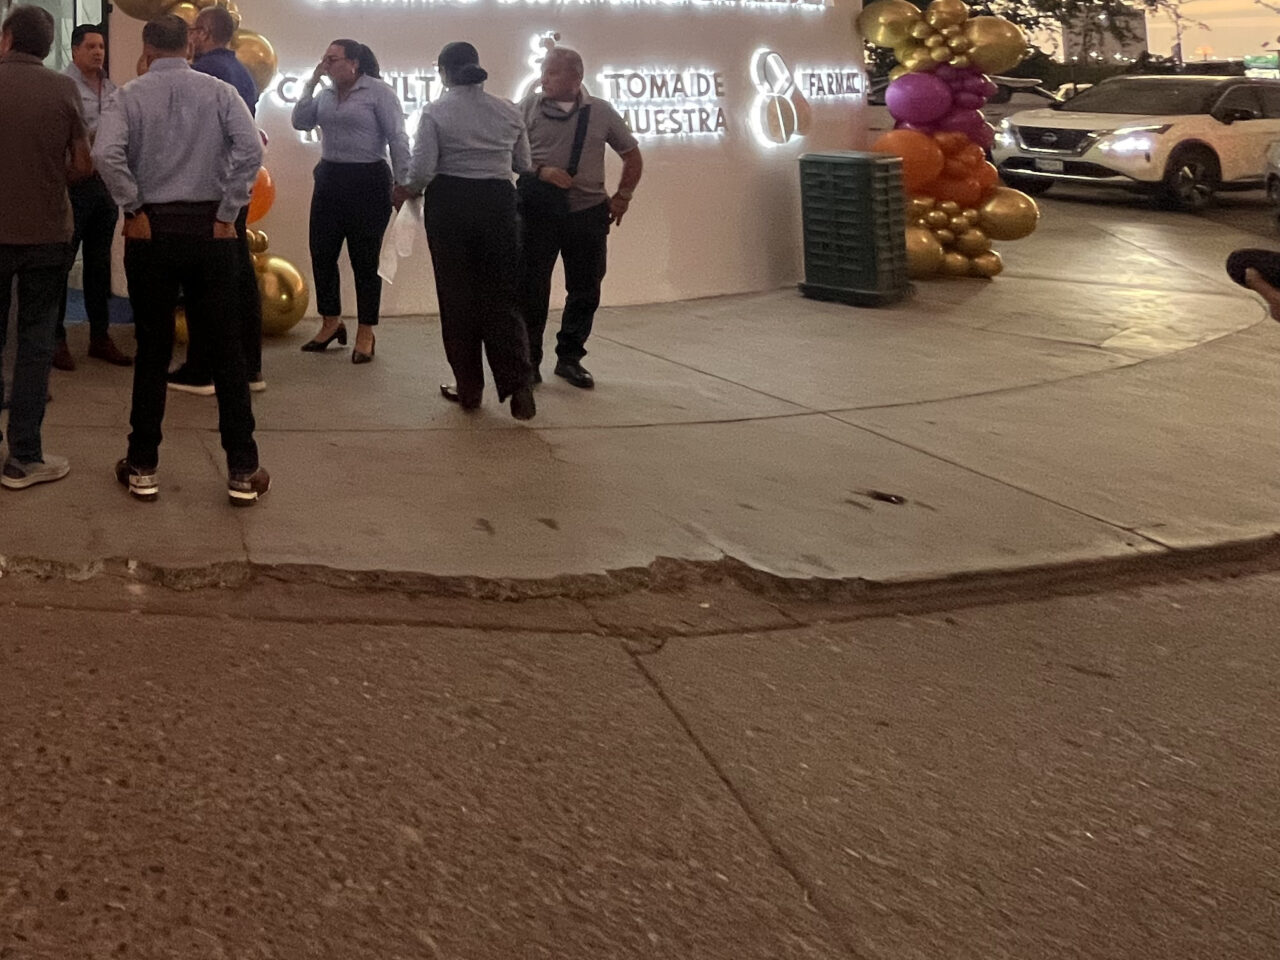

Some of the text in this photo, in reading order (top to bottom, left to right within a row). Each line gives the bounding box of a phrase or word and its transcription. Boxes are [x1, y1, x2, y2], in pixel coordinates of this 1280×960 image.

[604, 73, 726, 99] TOMA DE
[809, 73, 871, 97] FARMACI
